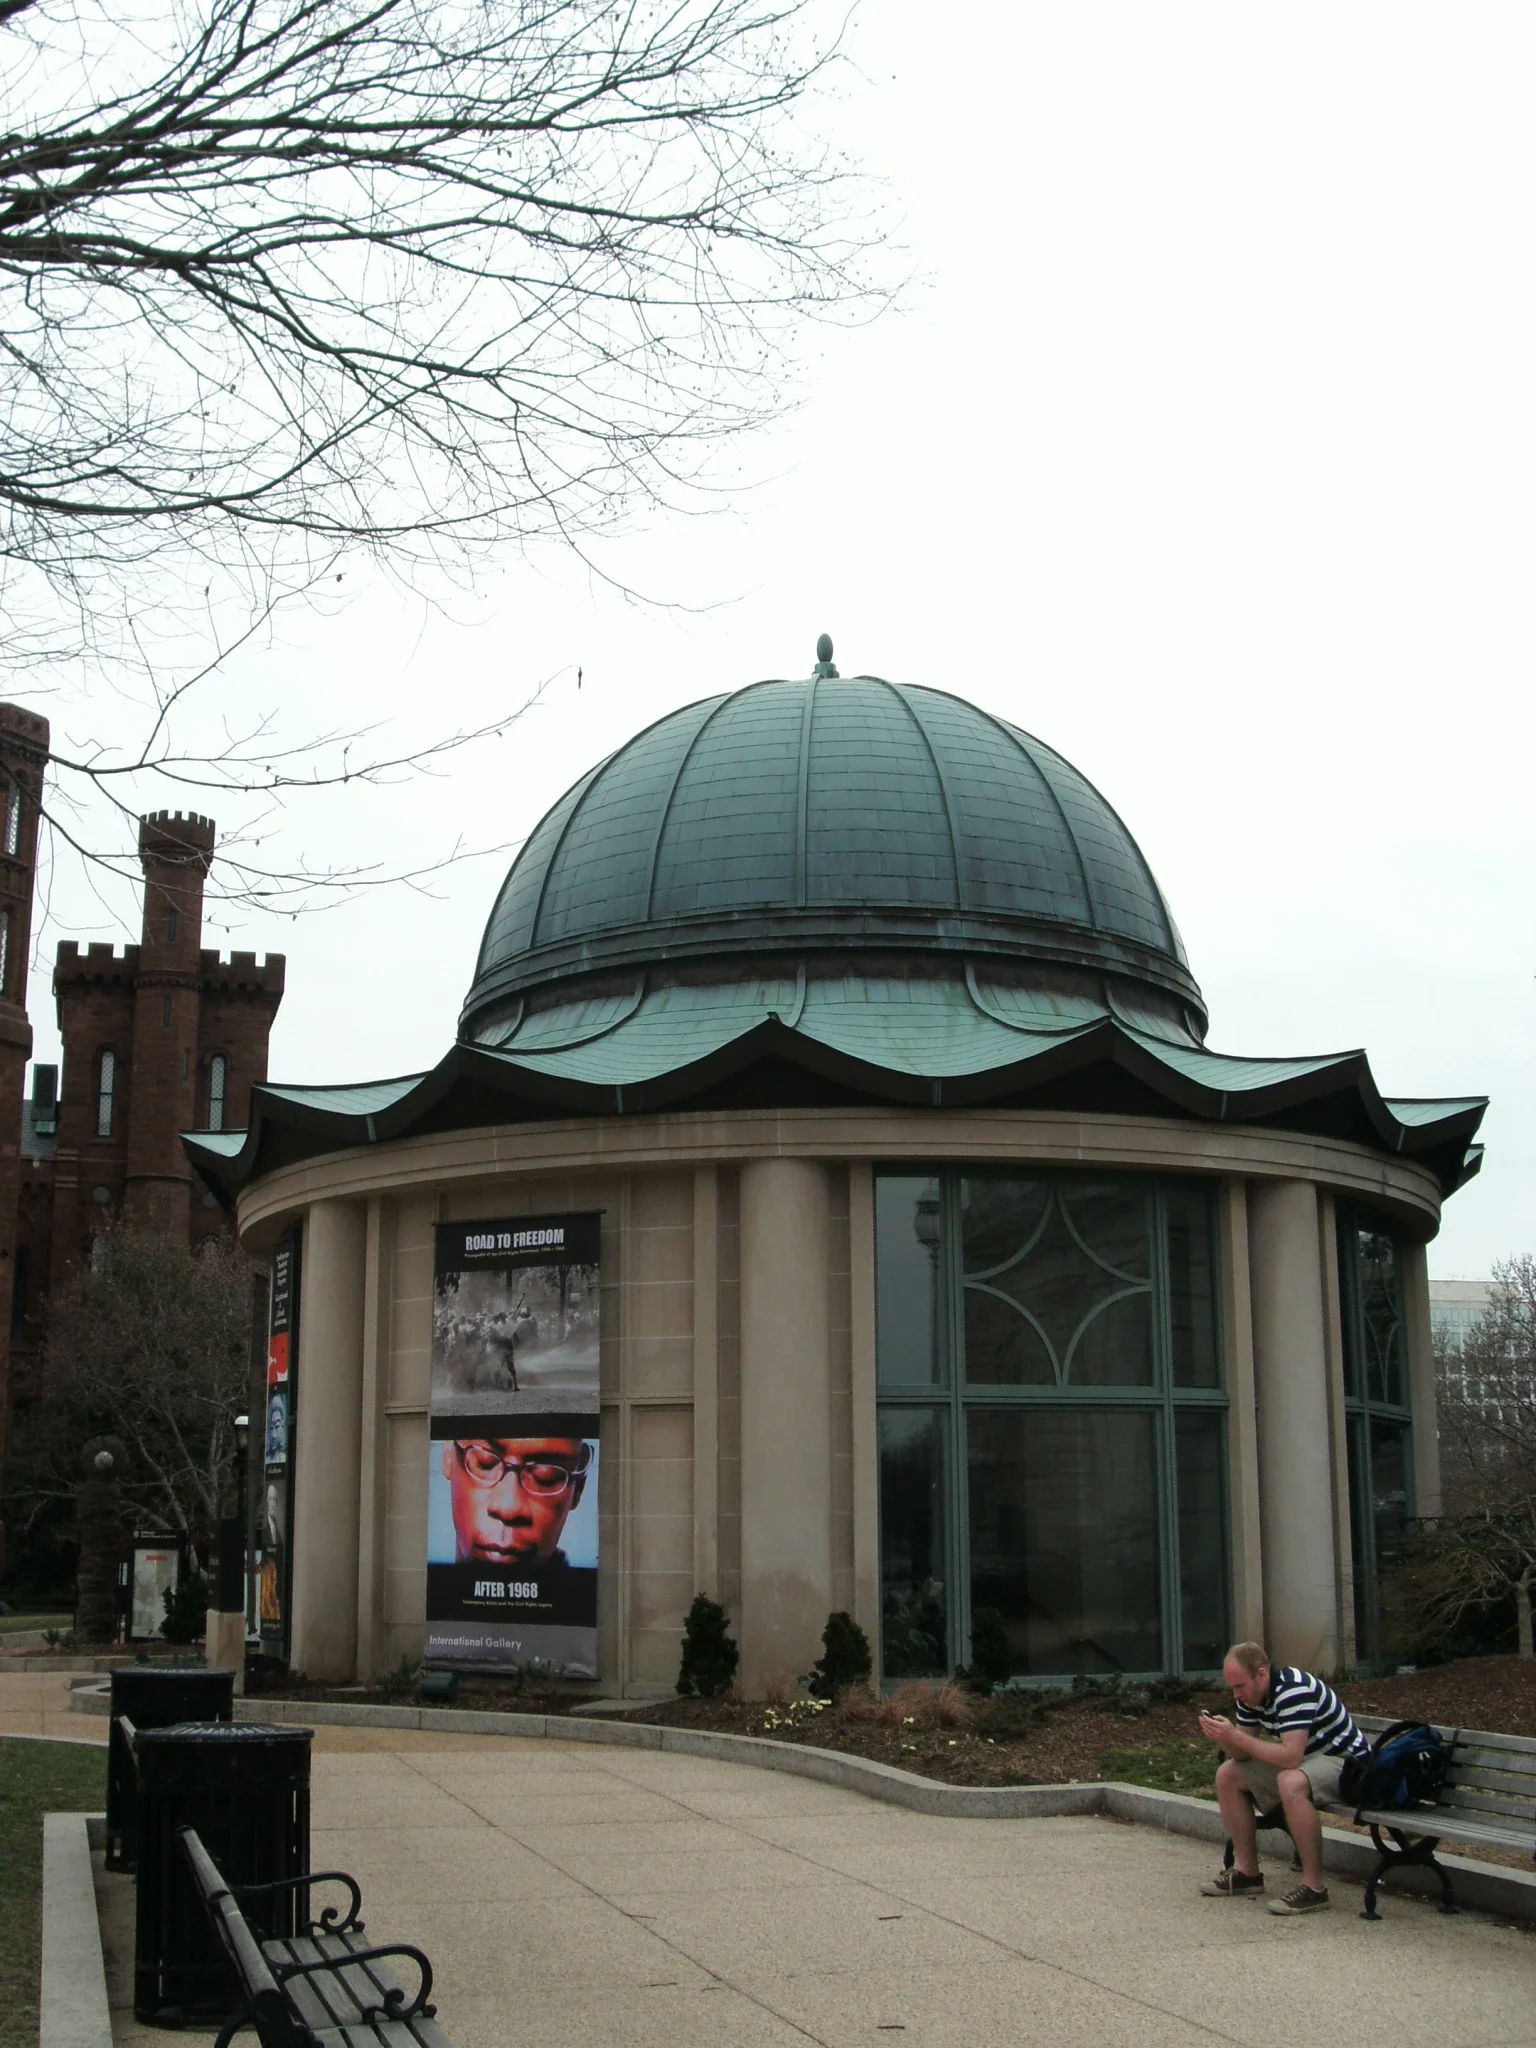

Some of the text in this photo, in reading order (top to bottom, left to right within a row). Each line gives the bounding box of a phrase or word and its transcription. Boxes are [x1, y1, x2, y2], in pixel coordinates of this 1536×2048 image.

[465, 1228, 564, 1251] ROAD TO FREEDOM
[474, 1581, 538, 1598] AFTER 1968
[429, 1635, 522, 1651] International Gallery
